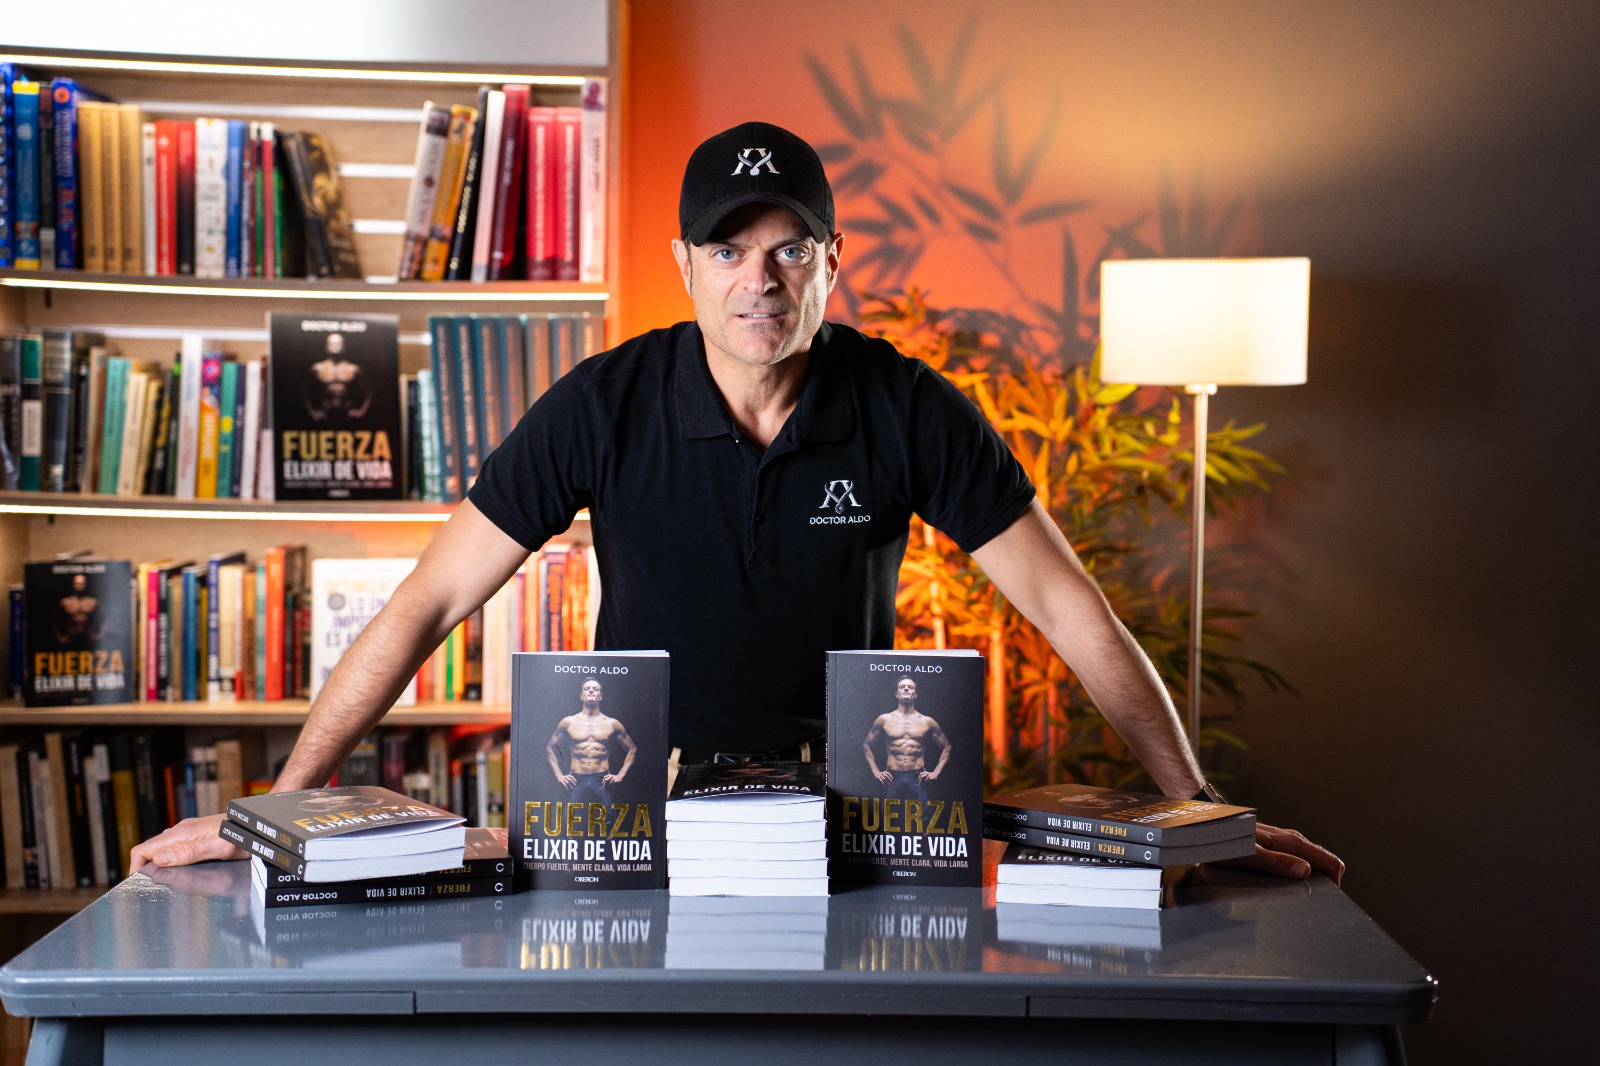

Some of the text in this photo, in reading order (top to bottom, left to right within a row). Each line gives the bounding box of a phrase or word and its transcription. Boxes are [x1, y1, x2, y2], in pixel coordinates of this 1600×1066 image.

[282, 430, 392, 460] FUERZA
[284, 460, 393, 480] ELIXIR DE VIDA
[810, 514, 870, 525] DOCTOR ALDO
[35, 650, 124, 676] FUERZA
[554, 666, 628, 674] DOCTOR ALDO
[870, 664, 942, 674] DOCTOR ALDO
[77, 674, 92, 690] DE
[684, 786, 738, 796] ELIXIR
[293, 806, 431, 828] FUERZA
[305, 816, 367, 832] ELIXIR
[368, 812, 391, 821] DE
[394, 810, 442, 818] VIDA
[524, 802, 652, 838] FUERZA
[842, 796, 968, 834] FUERZA
[1003, 812, 1027, 820] DOCTOR
[1048, 817, 1127, 836] FUERZA ELIXIR DE VIDA
[524, 838, 652, 860] ELIXIR DE VIDA
[842, 833, 968, 858] ELIXIR DE VIDA
[1046, 836, 1125, 856] FUERZA ELIXIR DE VIDA
[523, 862, 546, 870] CUERPO
[547, 862, 570, 872] FUERTE,
[594, 864, 615, 872] CLARA,
[890, 858, 910, 866] MENTE
[912, 859, 932, 867] CLARA,
[934, 860, 948, 868] VIDA
[950, 860, 968, 868] LARGA
[366, 884, 471, 898] FUERZA ELIXIR DE VIDA
